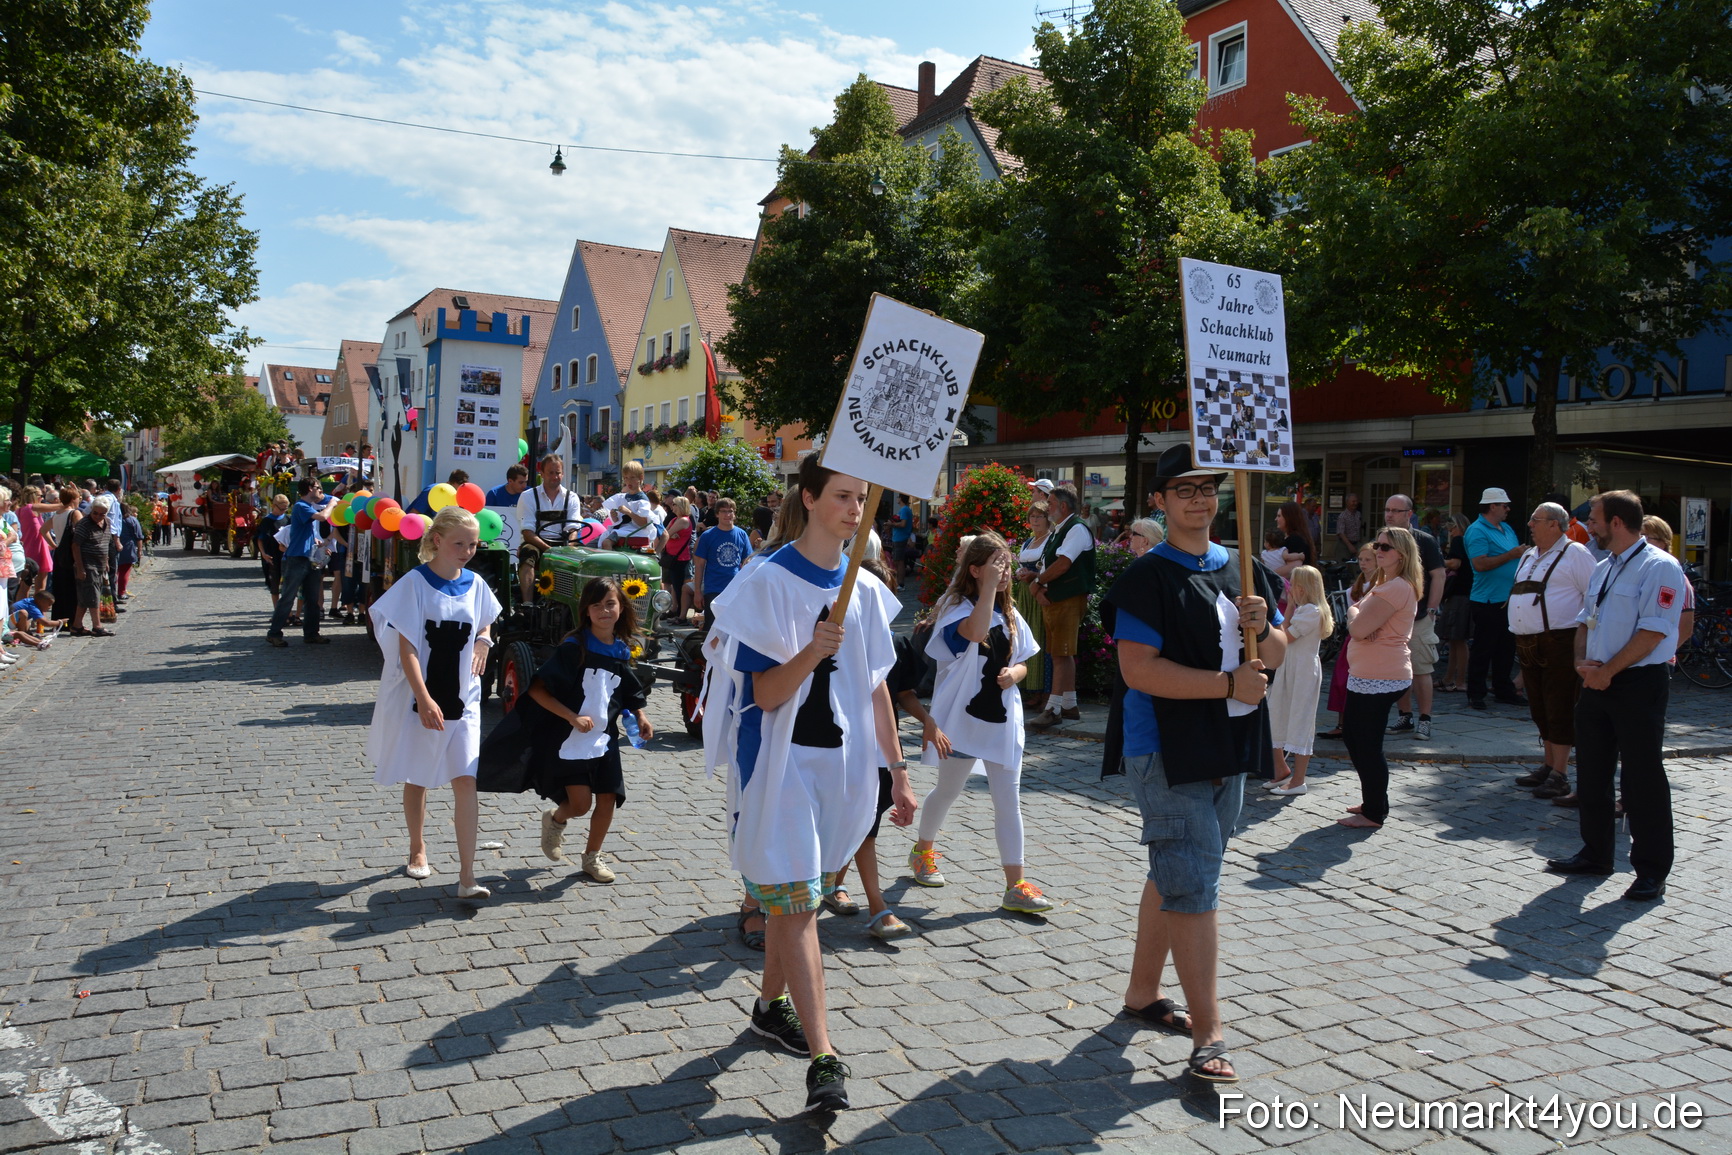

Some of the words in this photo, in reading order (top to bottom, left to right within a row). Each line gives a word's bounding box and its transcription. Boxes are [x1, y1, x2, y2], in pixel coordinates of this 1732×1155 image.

[1226, 272, 1241, 289] 65
[1217, 295, 1254, 315] Jahre
[1200, 317, 1274, 343] Schachklub
[1207, 342, 1271, 366] Neumarkt
[863, 338, 960, 397] SCHACHKLUB
[847, 396, 921, 461] NEUMARKT
